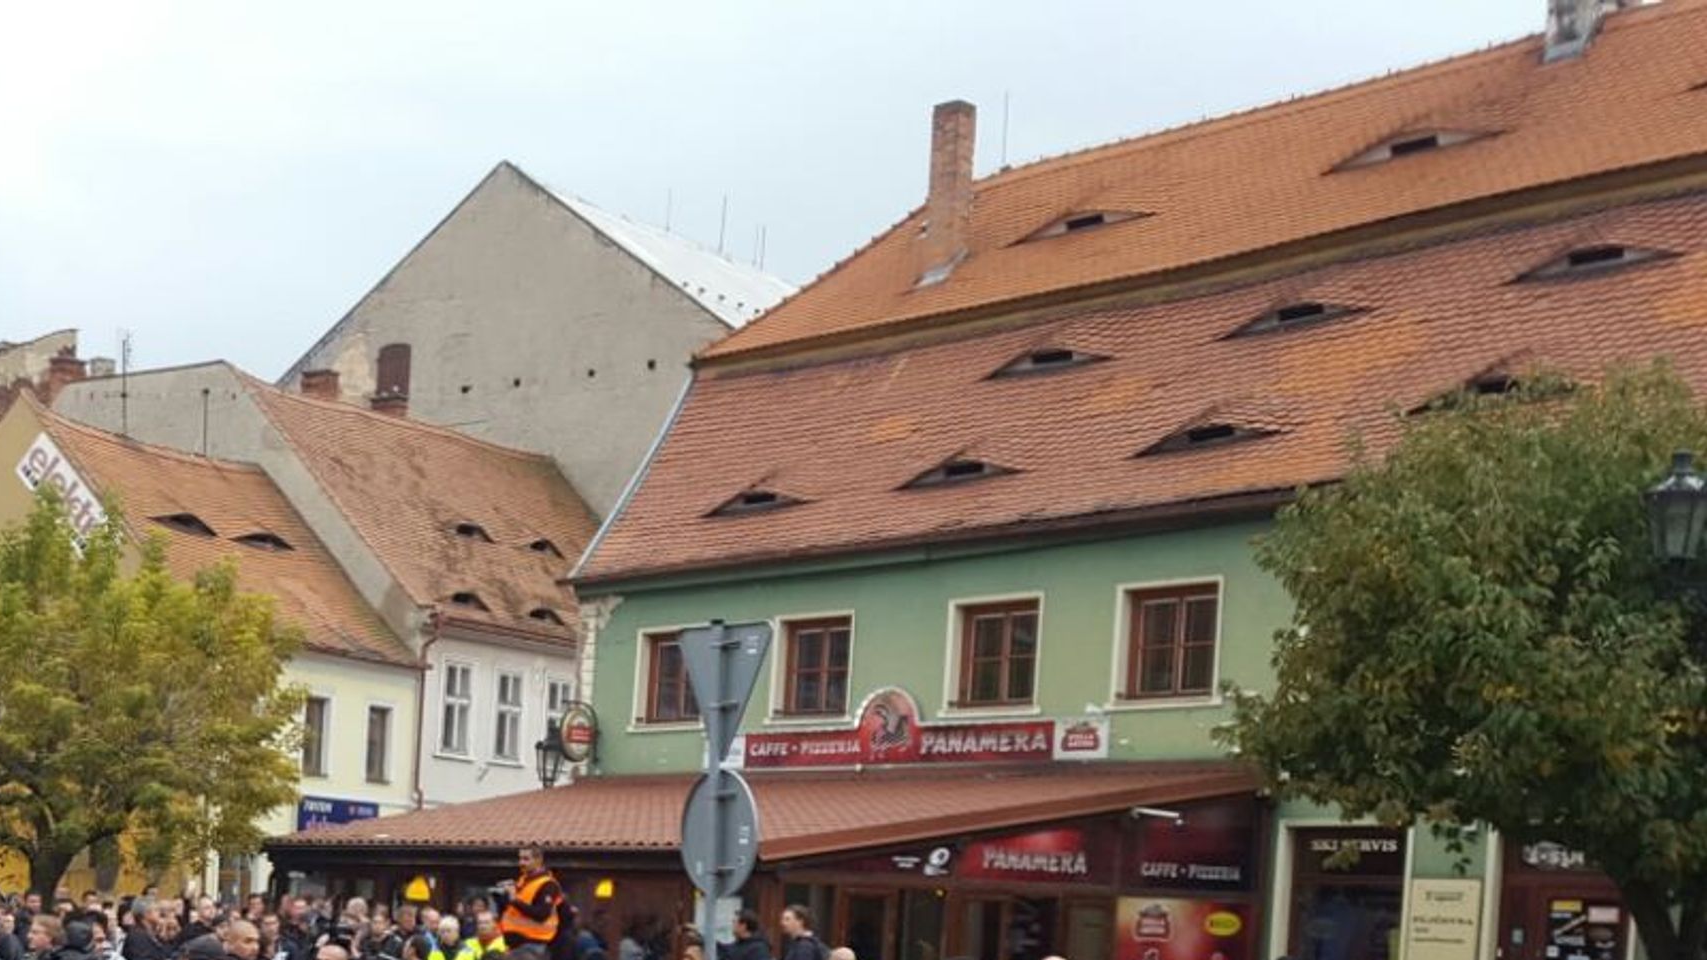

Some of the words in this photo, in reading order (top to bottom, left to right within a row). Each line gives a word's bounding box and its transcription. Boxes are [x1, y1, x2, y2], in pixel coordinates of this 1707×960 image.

[29, 448, 97, 535] elektr
[749, 742, 788, 757] CAFFE
[920, 731, 1048, 755] PANAMERA
[1311, 839, 1338, 851] SKI
[1341, 839, 1398, 852] SRVIS
[982, 847, 1087, 875] PANAMERA
